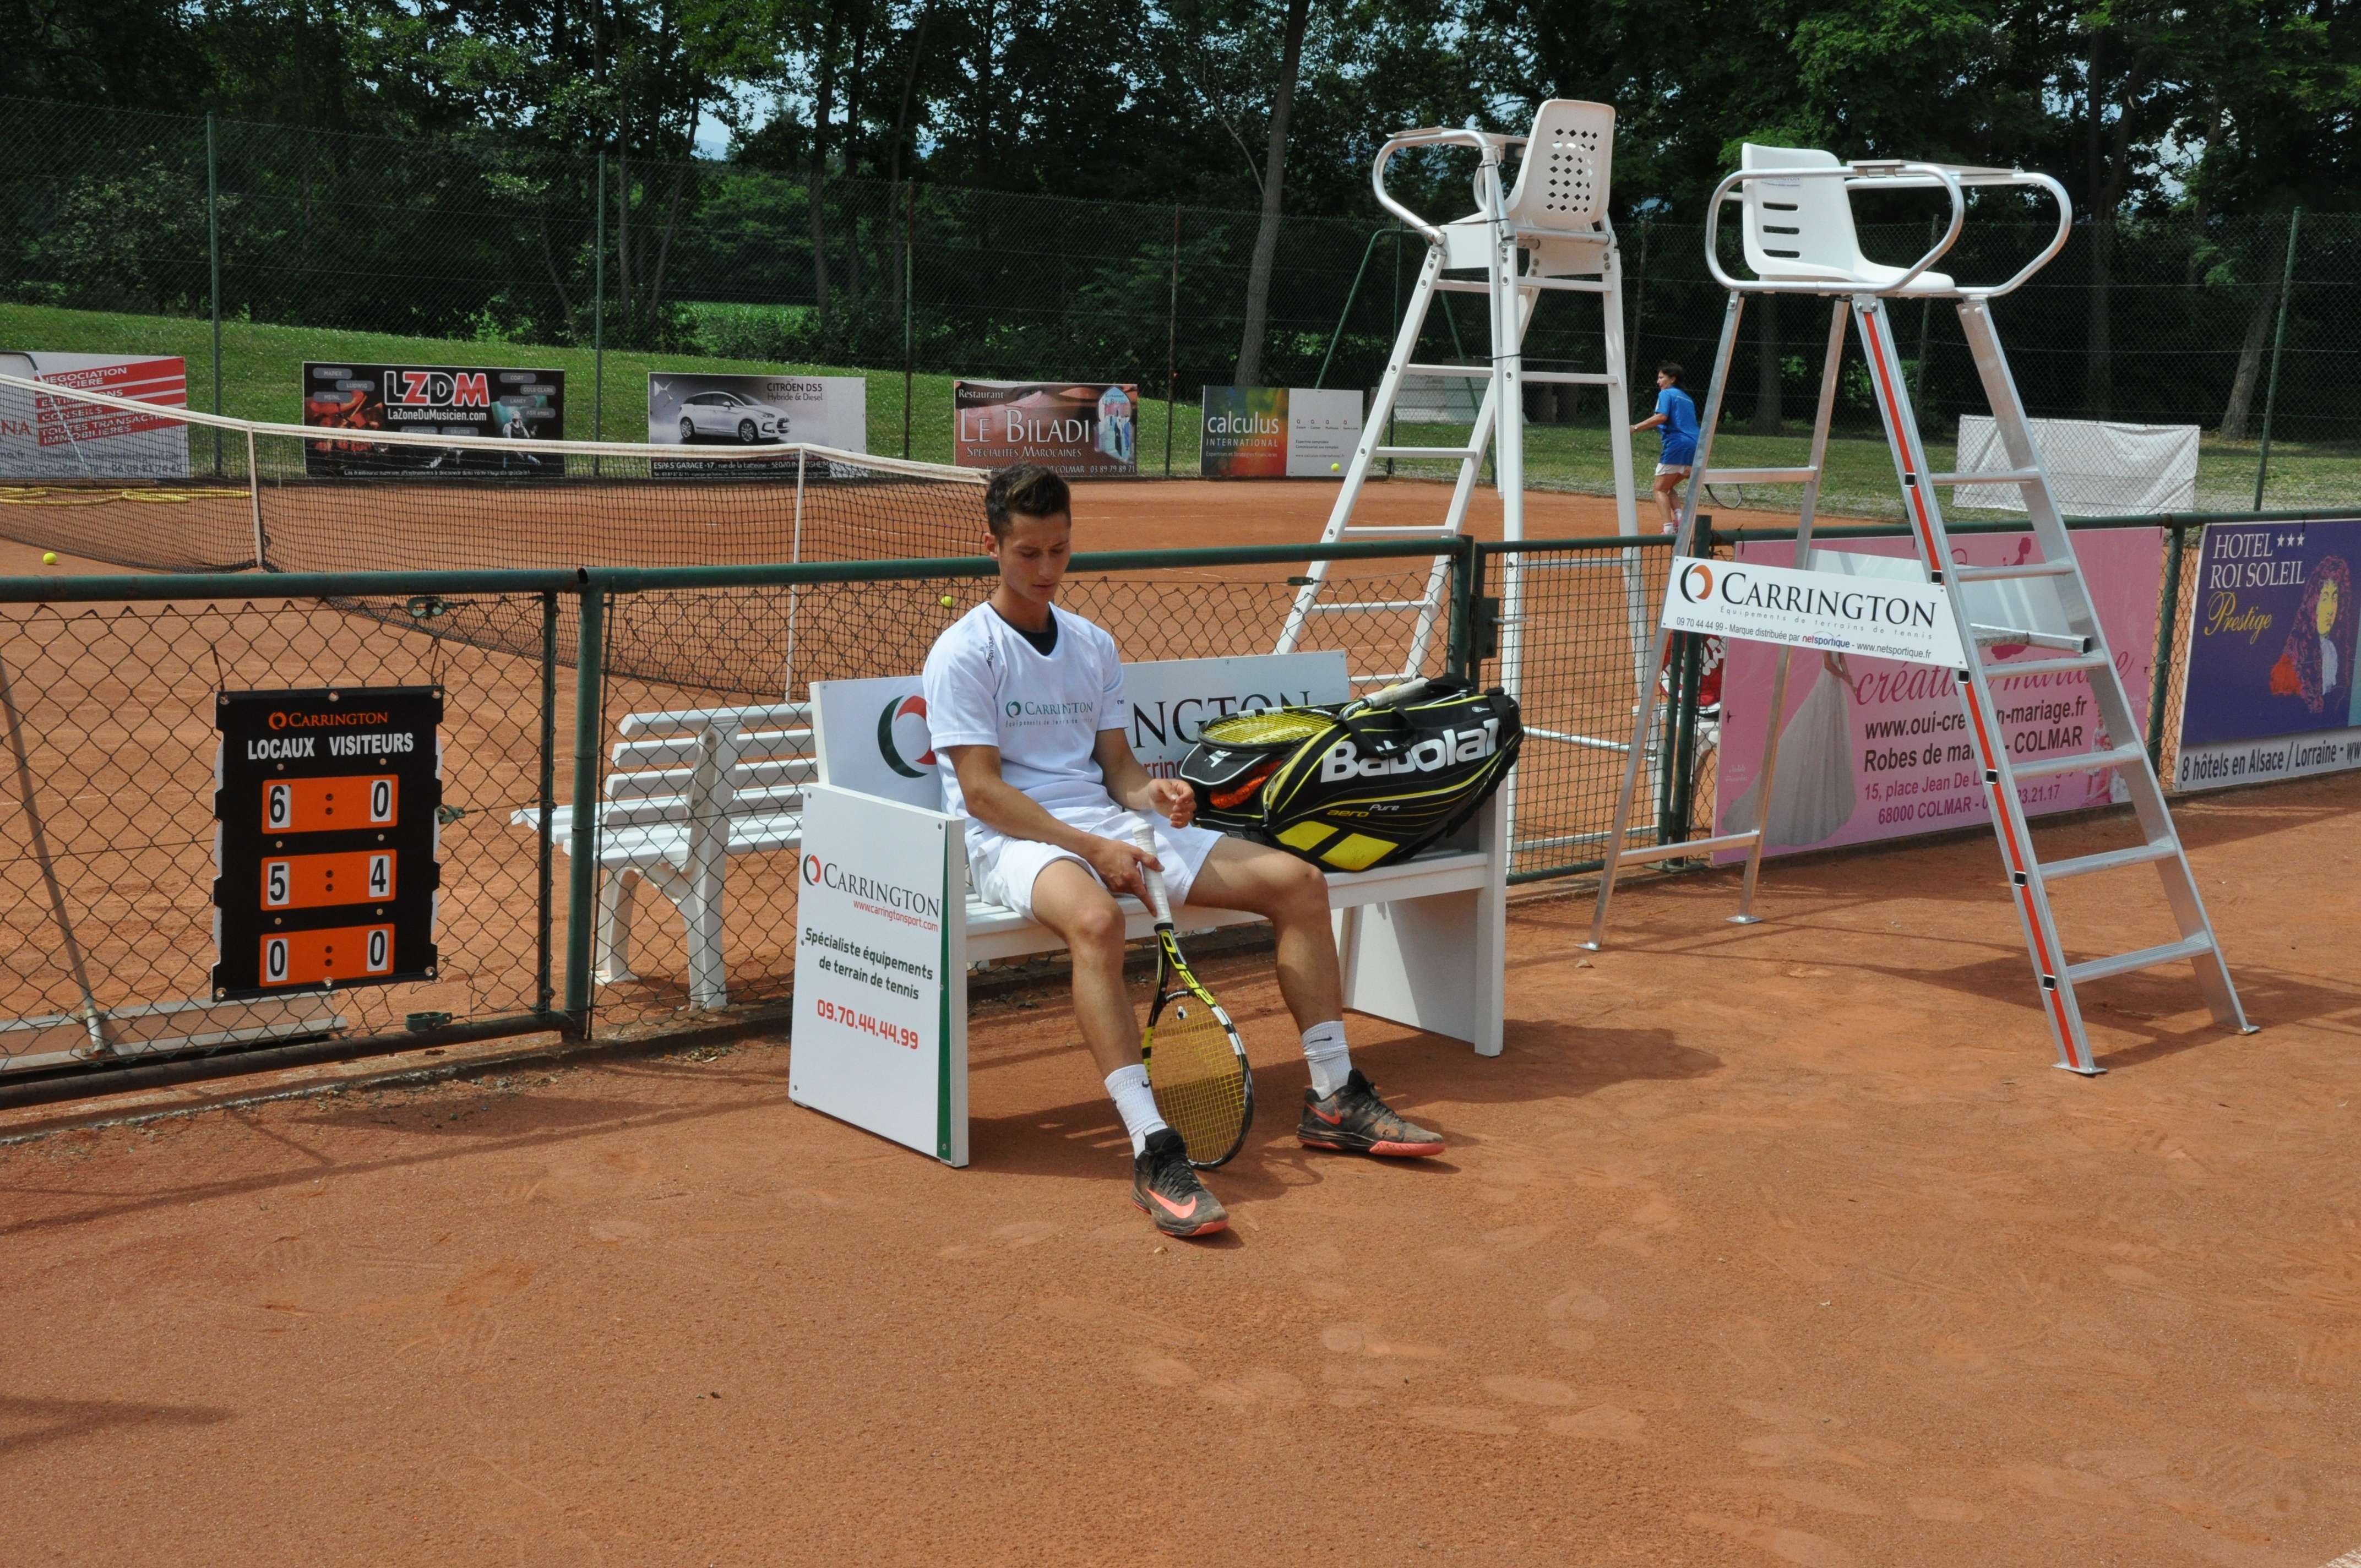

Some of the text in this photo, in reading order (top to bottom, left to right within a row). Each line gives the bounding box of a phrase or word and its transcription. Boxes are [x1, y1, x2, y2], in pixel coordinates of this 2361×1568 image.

[384, 371, 490, 407] LZDM
[767, 393, 793, 402] Hybride
[803, 393, 823, 401] Diesel
[806, 383, 823, 392] DS5
[959, 388, 1004, 399] Restaurant
[388, 408, 487, 421] LaZoneDuMusicien.com
[960, 408, 1090, 443] LE BILADI
[1207, 411, 1279, 434] calculus
[41, 424, 88, 437] TOUTES
[1206, 438, 1278, 447] INTERNATIONAL
[967, 445, 1081, 458] SPECIALITES MAROCAINES
[1056, 465, 1085, 473] COLMAR
[1090, 465, 1098, 473] 03
[1109, 465, 1117, 473] 79
[1118, 465, 1126, 473] 89
[2212, 532, 2273, 559] HOTEL
[2209, 561, 2306, 589] ROI SOLEIL
[1722, 572, 1936, 629] CARRINGTON
[1794, 616, 1805, 624] de
[1815, 619, 1864, 631] terrains
[1895, 629, 1932, 640] tennis
[2204, 591, 2273, 645] Prestige
[1676, 617, 1932, 658] 09 70 44 44 99 Marque distribuée par netsportique www.netsportique.fr
[289, 712, 388, 727] CARRINGTON
[248, 732, 414, 760] LOCAUX VISITEURS
[1320, 717, 1499, 783] Babolat
[1864, 747, 1917, 772] Robes
[1923, 743, 1942, 765] de
[2015, 726, 2083, 754] COLMAR
[2182, 756, 2190, 782] 8
[2193, 753, 2229, 781] hôtels
[2232, 755, 2246, 776] en
[2248, 748, 2284, 774] Alsace
[2295, 740, 2337, 767] Lorraine
[269, 781, 389, 823] 6 0
[1865, 783, 1881, 801] 15,
[1886, 780, 1918, 802] place
[1922, 776, 1950, 793] Jean
[1954, 772, 1969, 788] De
[1879, 804, 1914, 824] 68000
[1918, 796, 1971, 819] COLMAR
[269, 858, 387, 901] 5 4
[824, 863, 940, 918] CARRINGTON
[853, 900, 938, 933] www.carringtonsport.com
[269, 930, 385, 976] 0 0
[805, 927, 933, 981] Spécialiste équipements
[819, 956, 919, 1000] de terrain de tennis
[817, 999, 918, 1049] 09.70.44.44.99
